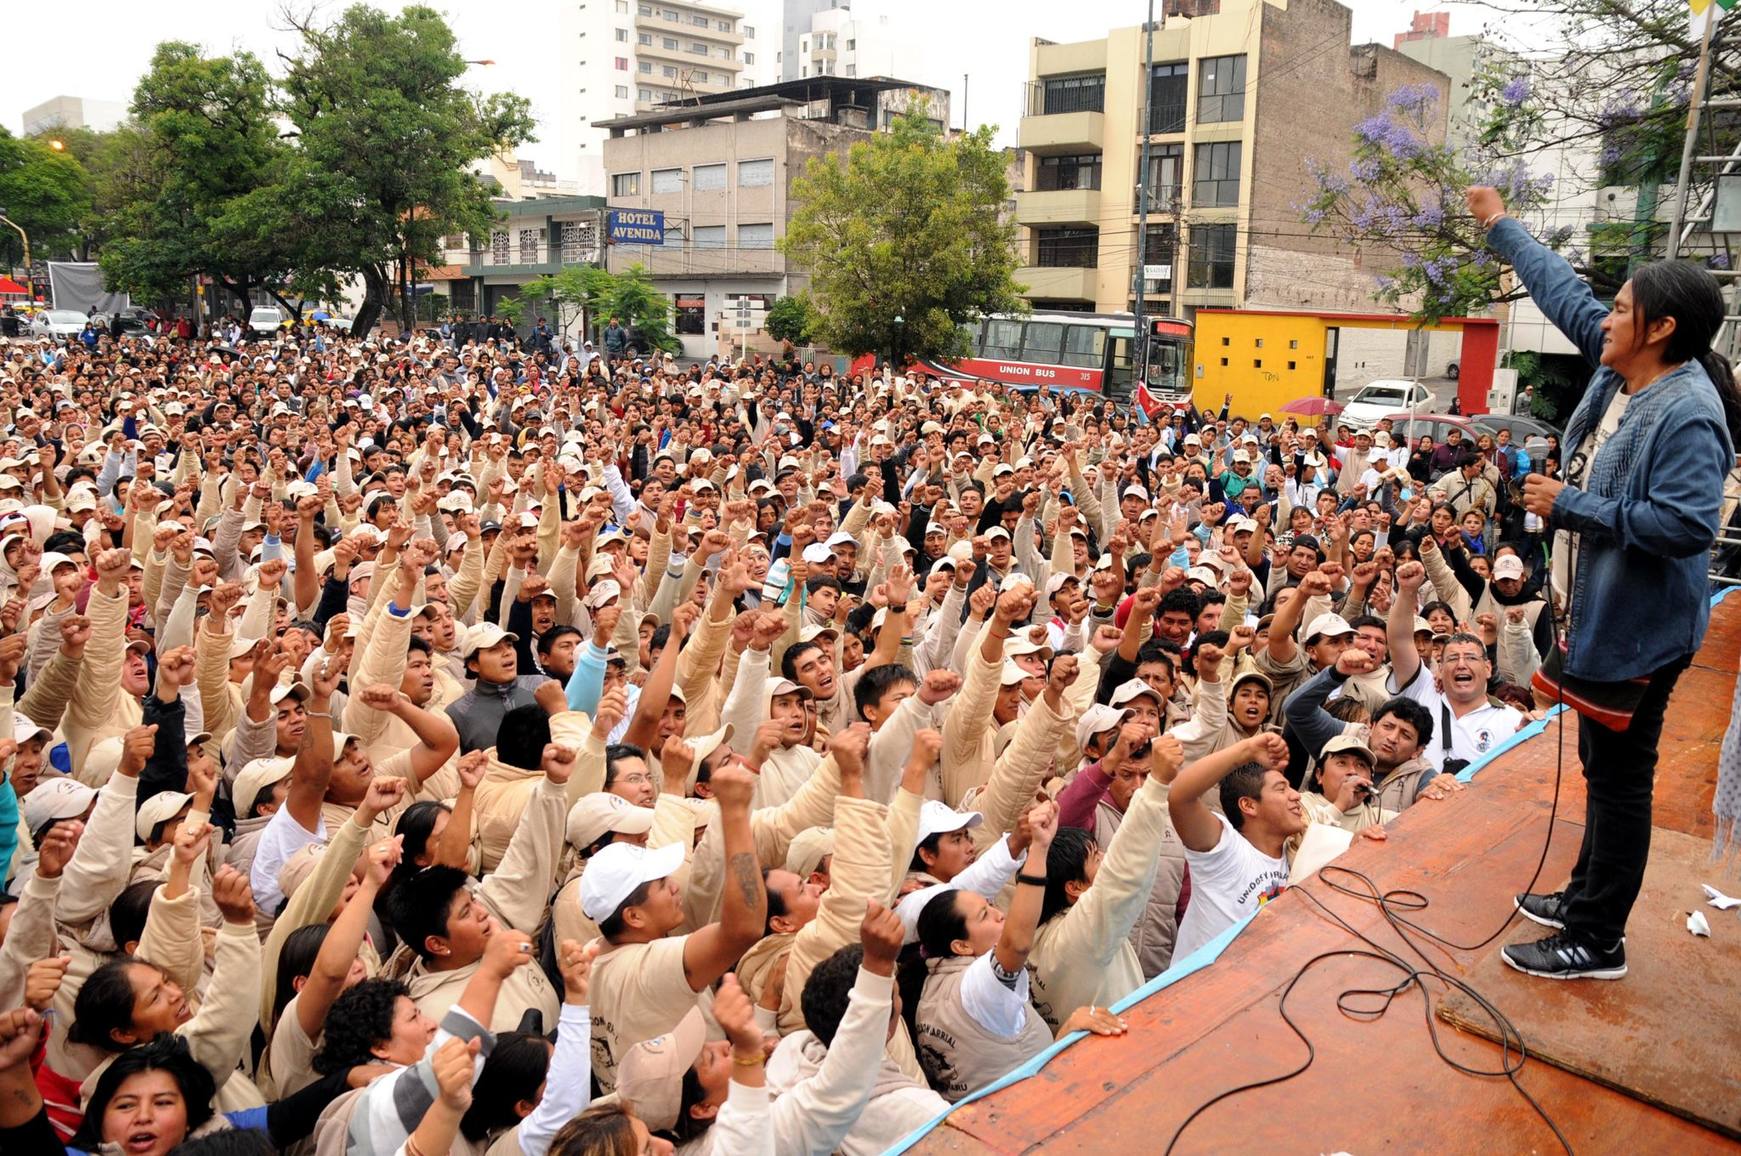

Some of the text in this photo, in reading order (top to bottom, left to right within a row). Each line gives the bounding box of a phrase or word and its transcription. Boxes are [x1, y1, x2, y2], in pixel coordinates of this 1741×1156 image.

[617, 211, 656, 225] HOTEL
[613, 226, 661, 241] AVENIDA
[999, 365, 1056, 378] UNION BUS
[929, 1026, 957, 1048] ARRIAL
